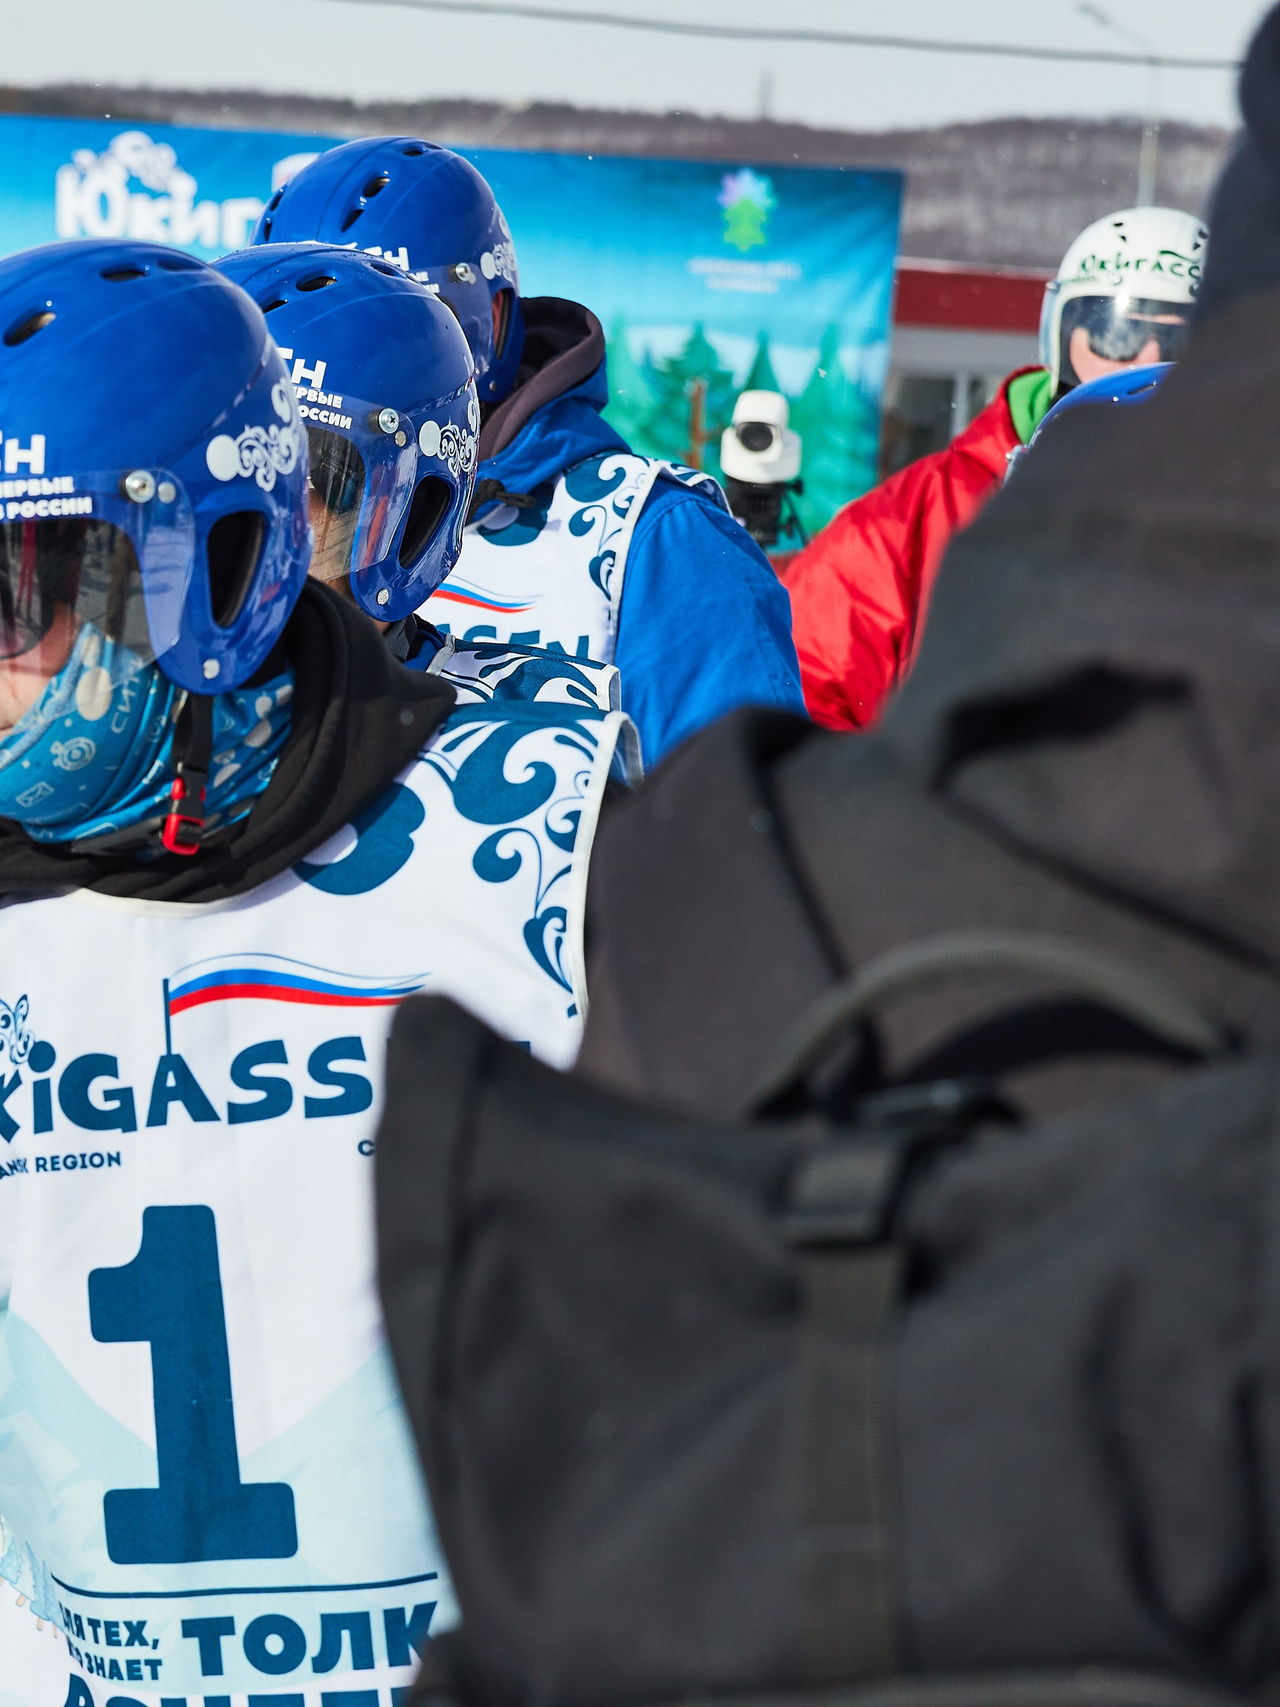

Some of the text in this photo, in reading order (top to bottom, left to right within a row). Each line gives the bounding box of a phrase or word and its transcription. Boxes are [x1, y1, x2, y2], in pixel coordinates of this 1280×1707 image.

[298, 404, 353, 430] ОССИИ
[6, 496, 93, 520] РОССИИ
[34, 1151, 122, 1173] REGION
[88, 1205, 298, 1564] 1
[86, 1616, 160, 1650] ТЕХ,
[180, 1600, 438, 1678] ТОЛК
[84, 1651, 163, 1681] ЗНАЕТ
